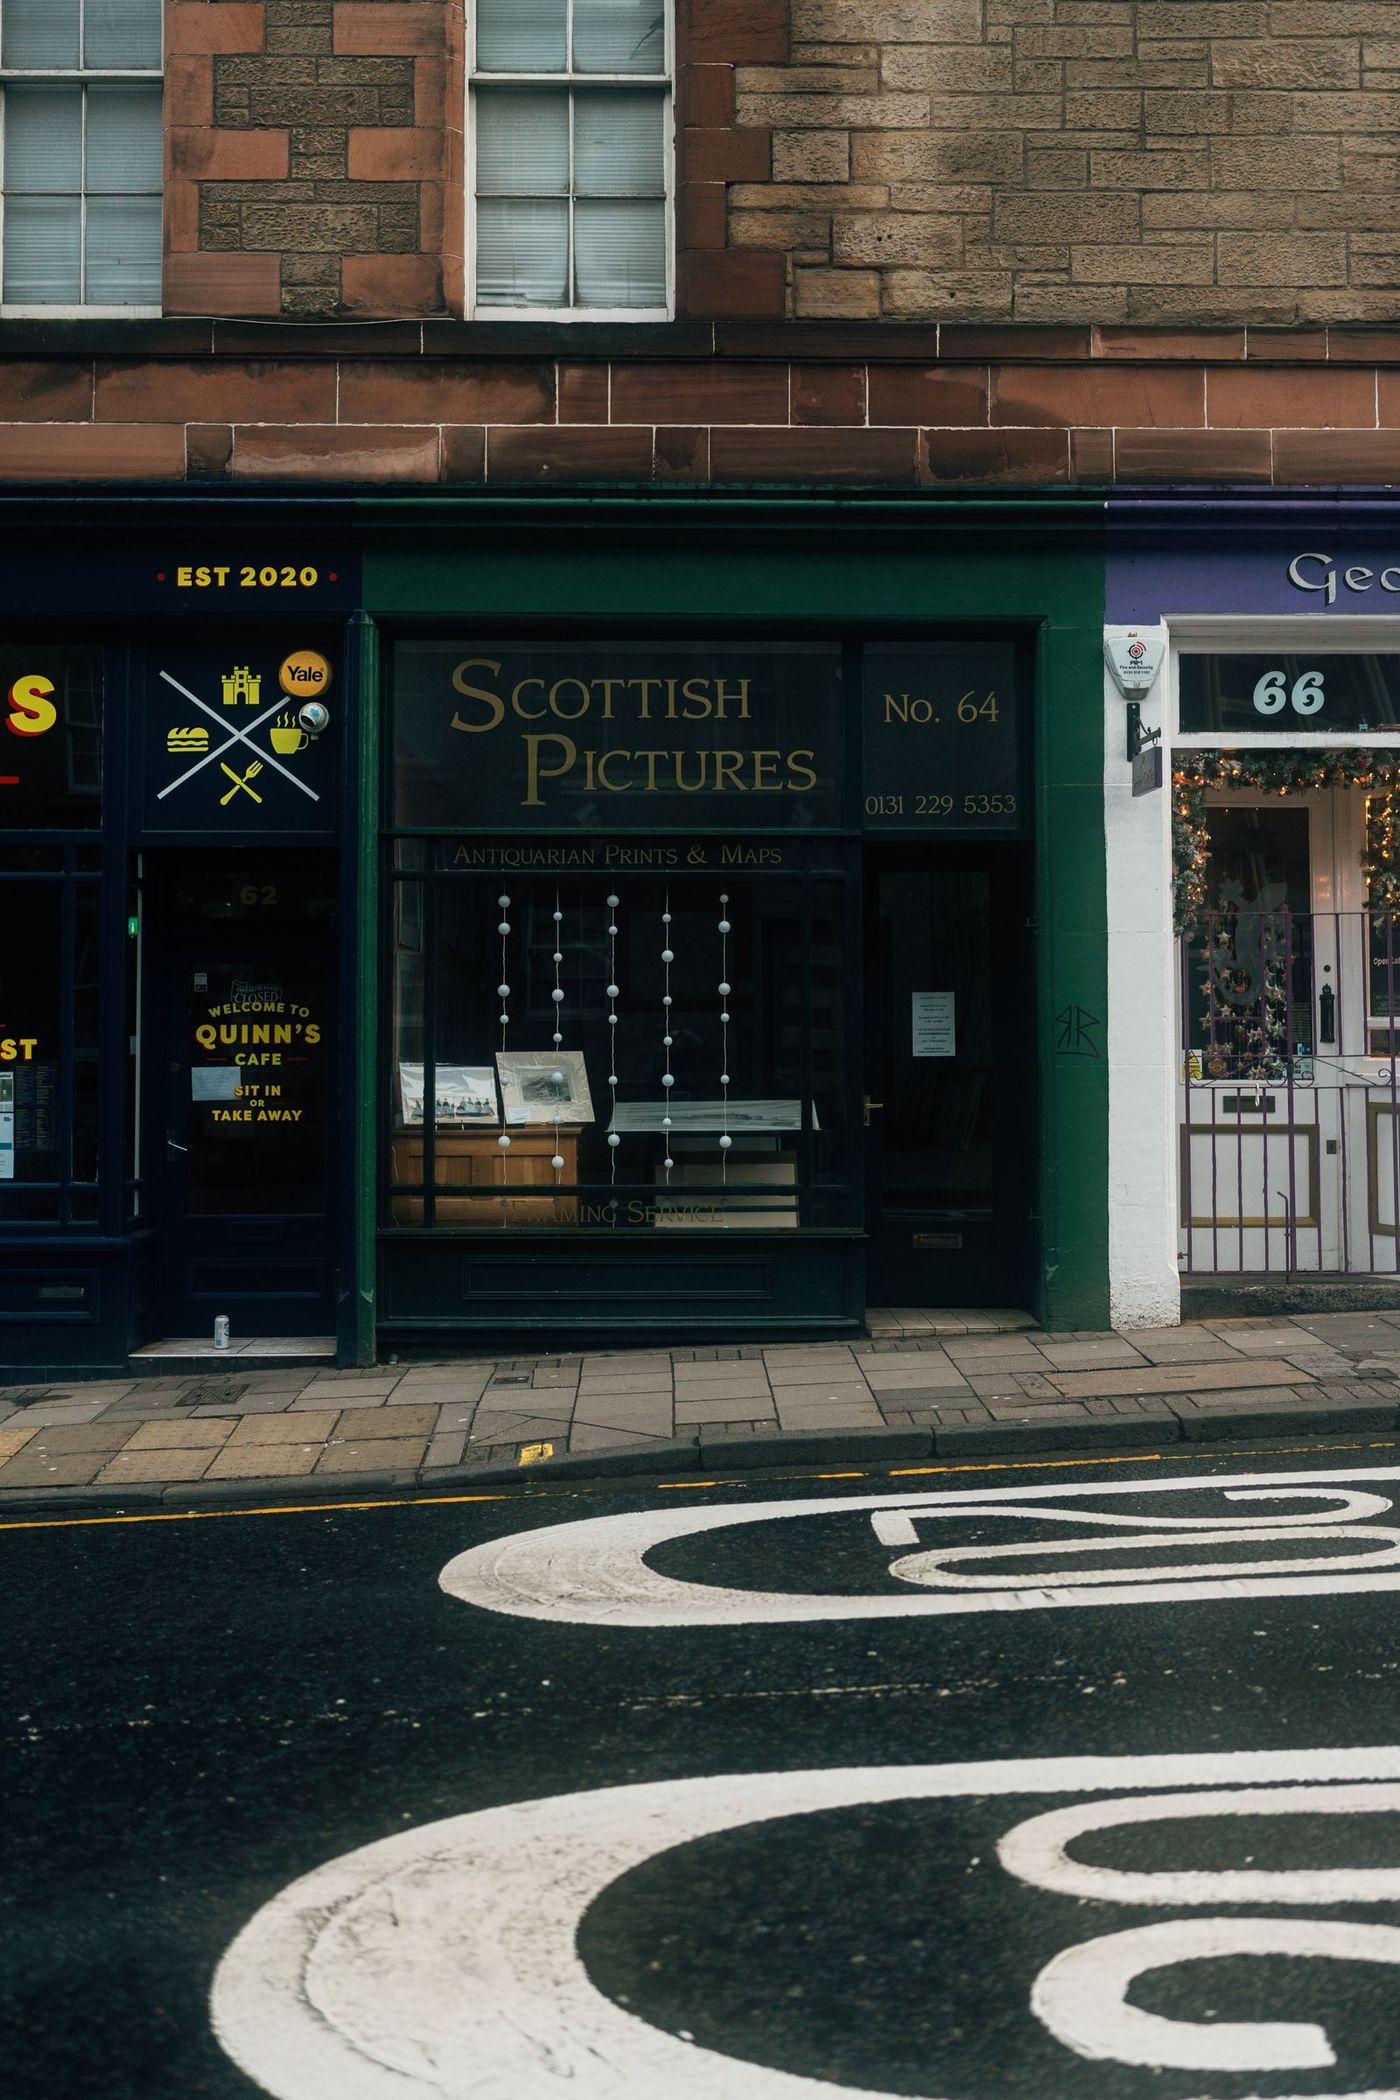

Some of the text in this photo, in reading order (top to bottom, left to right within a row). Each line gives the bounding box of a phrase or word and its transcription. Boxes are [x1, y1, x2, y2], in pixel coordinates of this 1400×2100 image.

[176, 566, 319, 588] EST 2020
[287, 665, 324, 683] Yale
[450, 657, 753, 734] SCOTTISH
[1252, 670, 1326, 716] 66
[4, 673, 58, 738] S
[883, 689, 999, 724] No. 64
[519, 733, 818, 806] PICTURES
[864, 794, 1017, 816] 0131 229 5353
[452, 843, 783, 867] ANTIQUARIAN PRINTS & MAPS
[240, 884, 279, 906] 62
[234, 990, 279, 1005] CLOSED
[207, 1001, 310, 1019] WELCOME TO
[195, 1023, 322, 1051] QUINN'S
[234, 1052, 282, 1067] CAFE
[234, 1084, 281, 1097] SIT IN
[249, 1099, 266, 1108] OR
[211, 1109, 303, 1122] TAKE AWAY
[511, 1199, 725, 1224] FRAMING SERVICE
